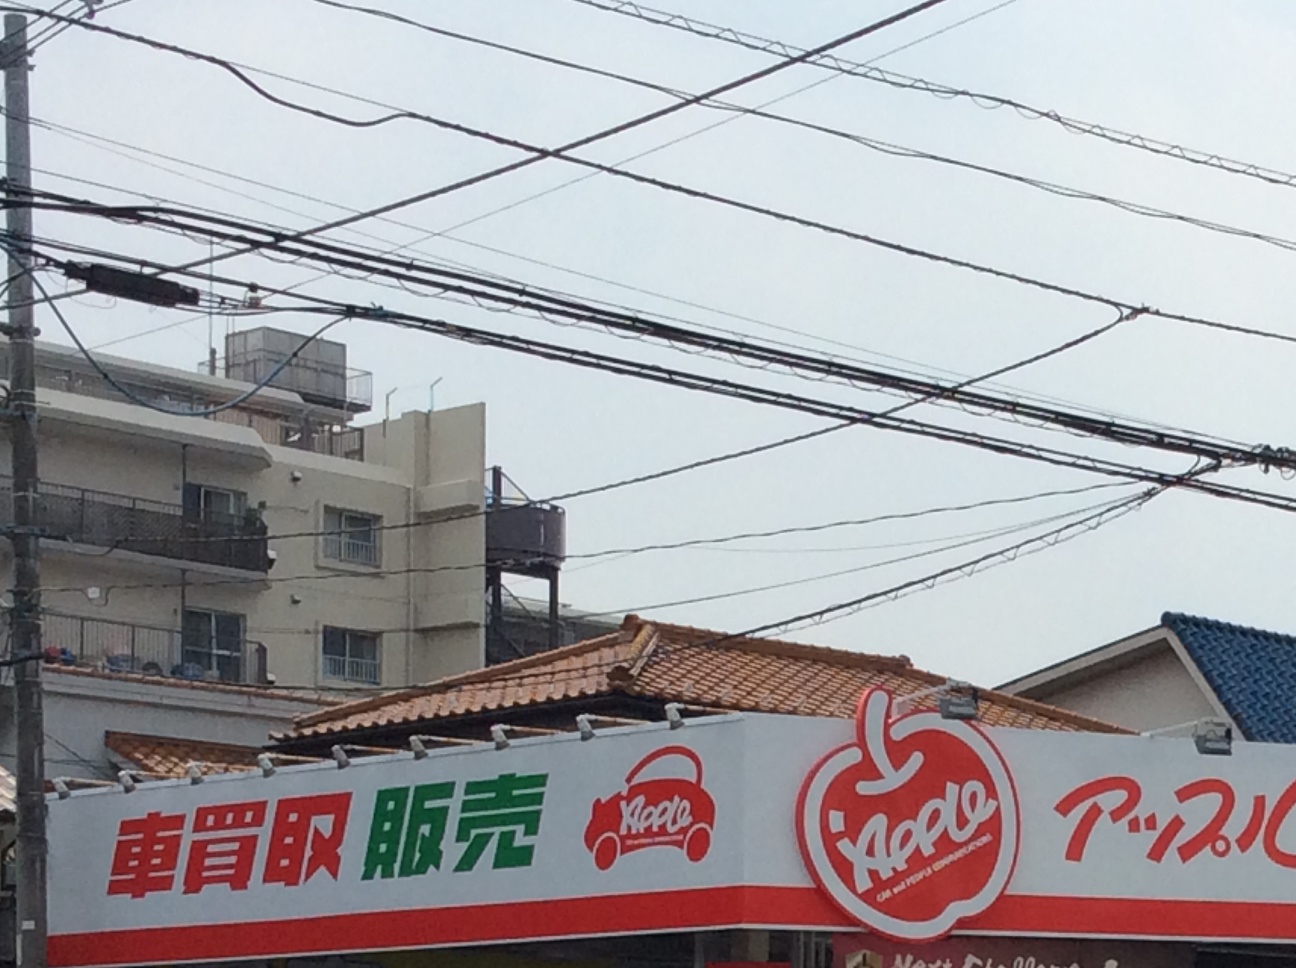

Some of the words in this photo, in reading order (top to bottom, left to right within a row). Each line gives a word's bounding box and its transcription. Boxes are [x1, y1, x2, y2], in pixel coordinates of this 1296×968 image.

[106, 791, 354, 899] 車買取
[361, 772, 549, 882] 販売
[619, 794, 694, 836] Apple
[828, 779, 999, 895] Apple
